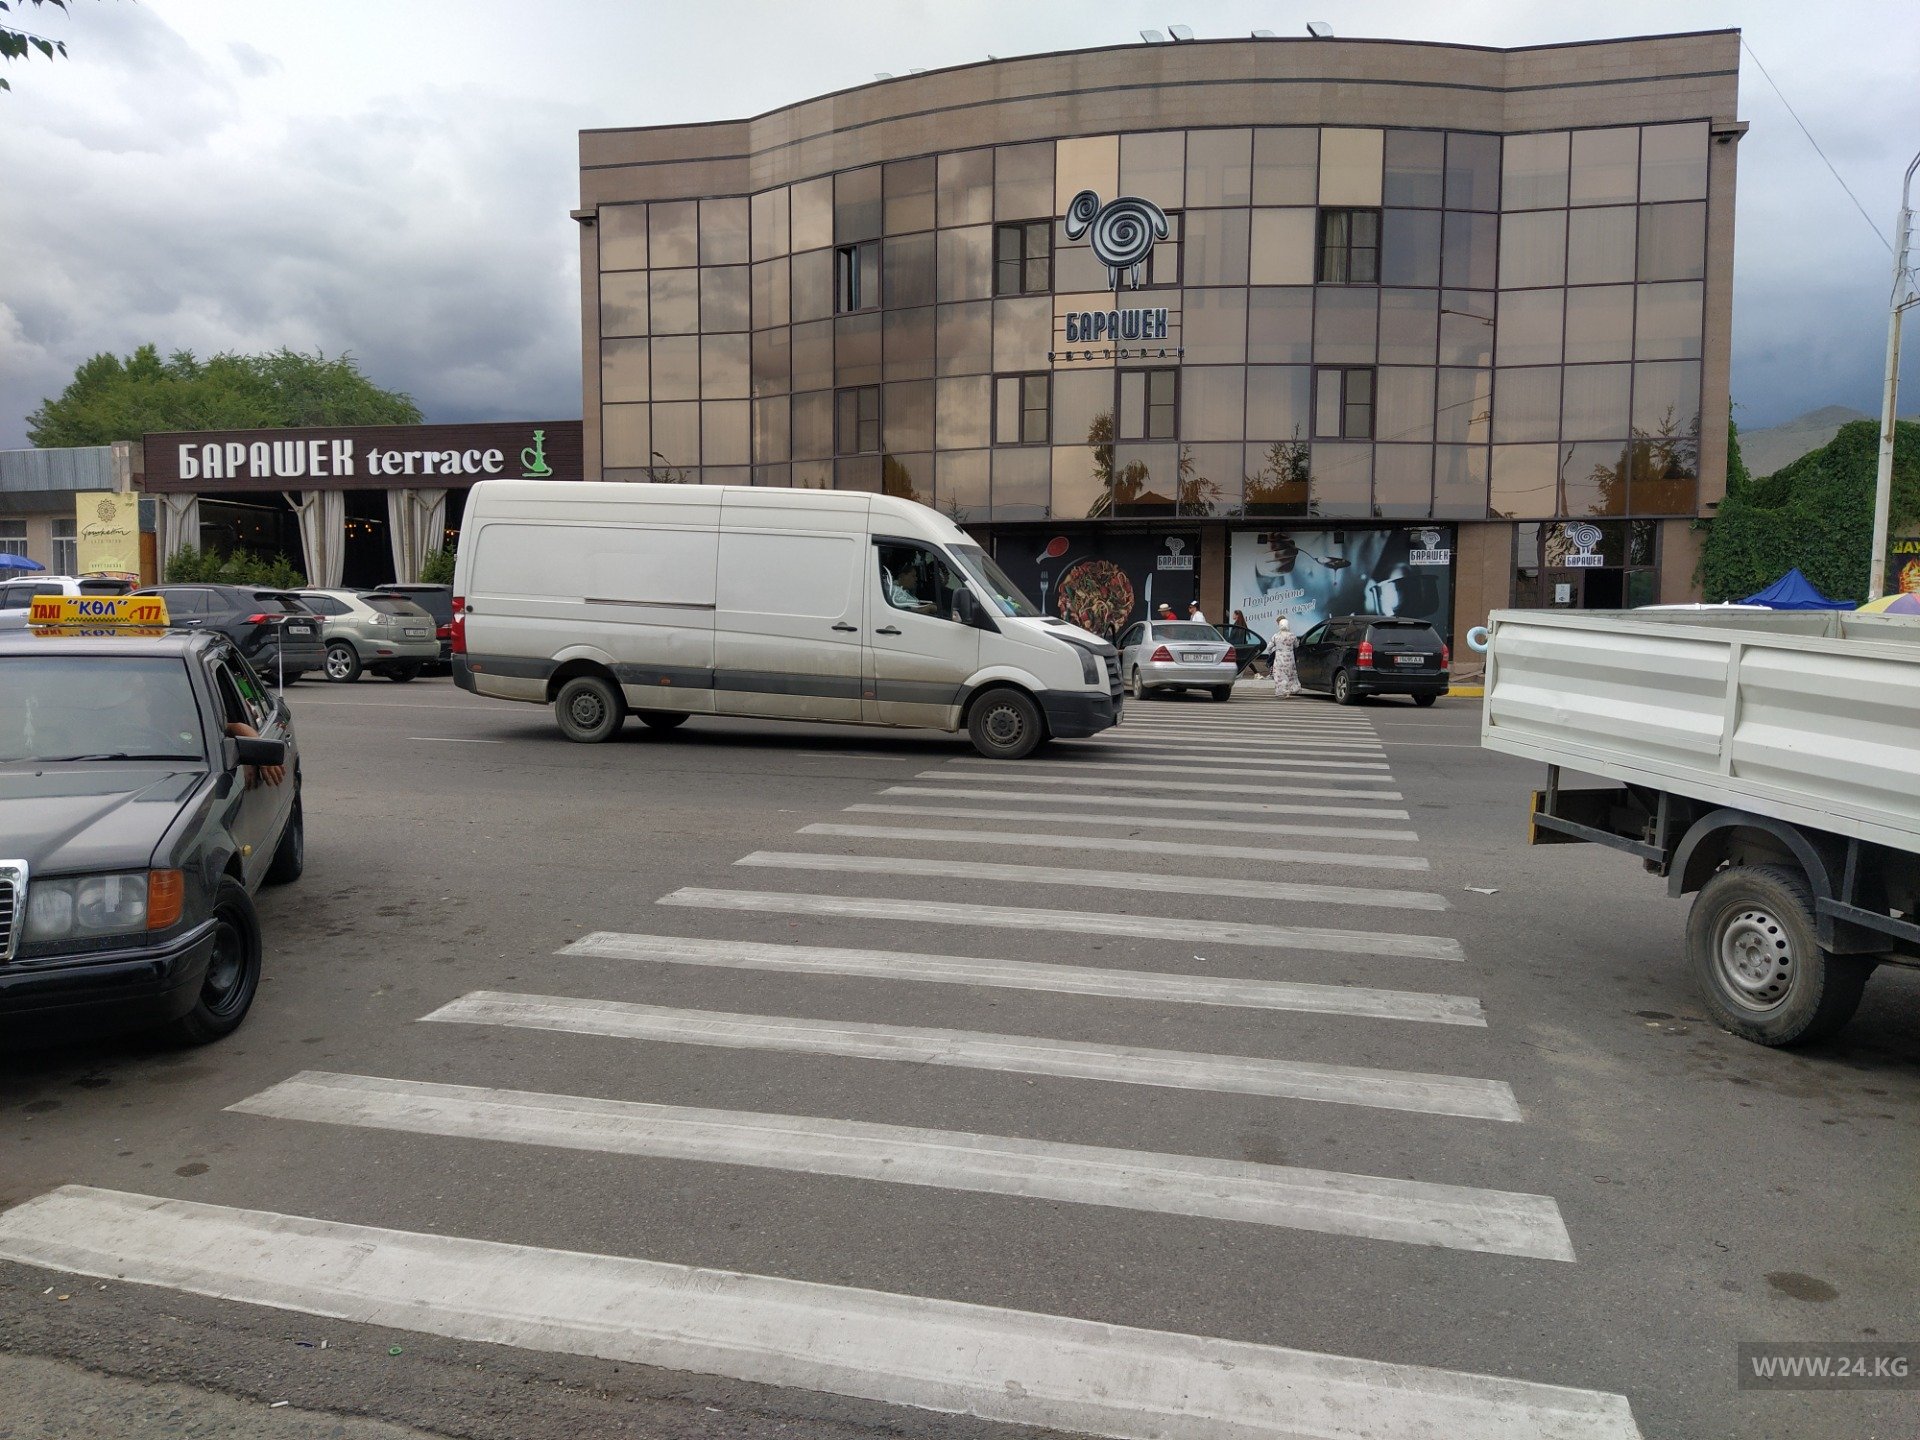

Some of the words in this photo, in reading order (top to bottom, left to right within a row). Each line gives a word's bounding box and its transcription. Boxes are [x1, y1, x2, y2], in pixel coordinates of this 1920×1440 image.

[1065, 308, 1169, 343] БАРАШЕК
[1047, 347, 1185, 363] РЕСТОРАН
[178, 439, 355, 480] БАРАШЕК
[366, 447, 505, 476] terrace
[1410, 549, 1449, 561] БАРАШЕК
[1566, 556, 1603, 566] БАРАШЕК
[1243, 588, 1305, 608] Попробуйте
[32, 604, 62, 619] TAXI
[138, 605, 161, 620] 177
[1245, 611, 1273, 622] оции
